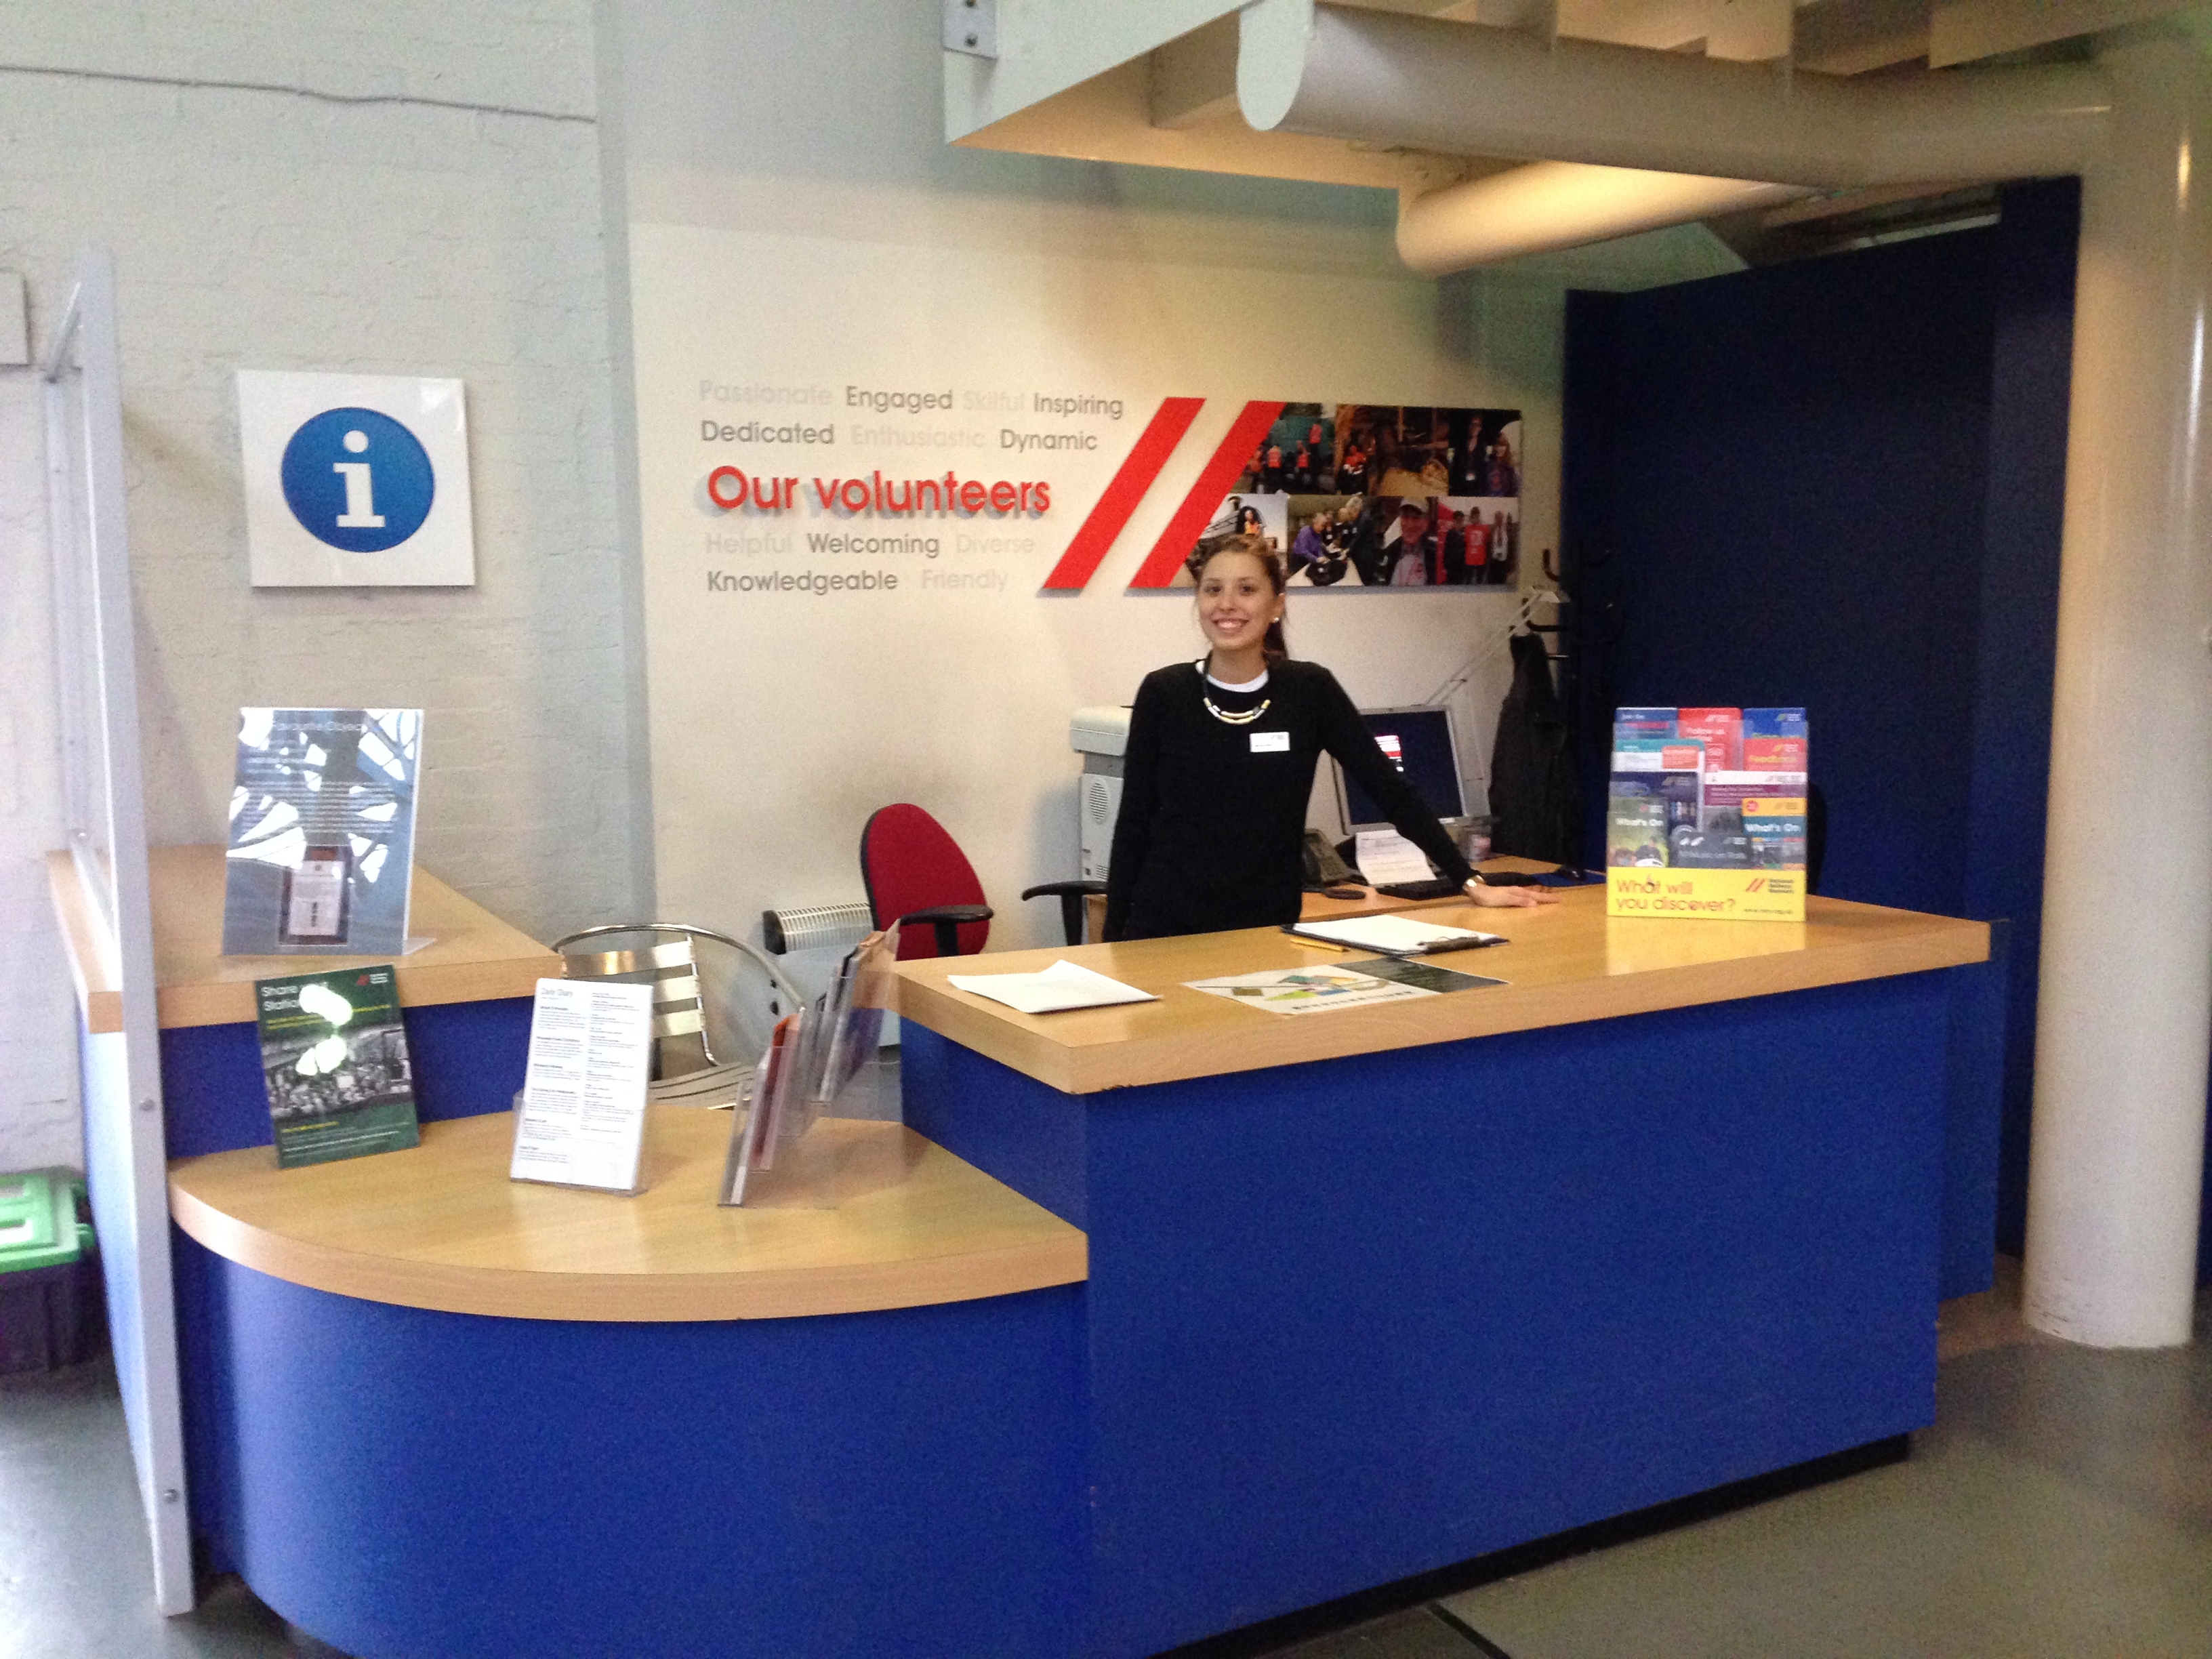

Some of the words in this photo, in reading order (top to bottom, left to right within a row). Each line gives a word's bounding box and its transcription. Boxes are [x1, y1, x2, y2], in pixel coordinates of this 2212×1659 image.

[699, 380, 833, 405] Passionate
[845, 385, 953, 414] Engaged
[1033, 392, 1124, 419] Inspiring
[701, 419, 834, 445] Dedicated
[851, 424, 985, 448] Enthusiastic
[1000, 428, 1097, 453] Dynamic
[707, 465, 799, 509] Our
[813, 470, 1051, 512] volunteers
[705, 532, 792, 557] Helpful
[806, 533, 939, 558] Welcoming
[956, 533, 1034, 554] Diverse
[707, 570, 898, 595] Knowledgeable
[921, 569, 1008, 592] Friendly
[1616, 879, 1660, 894] What
[1616, 898, 1647, 912] you
